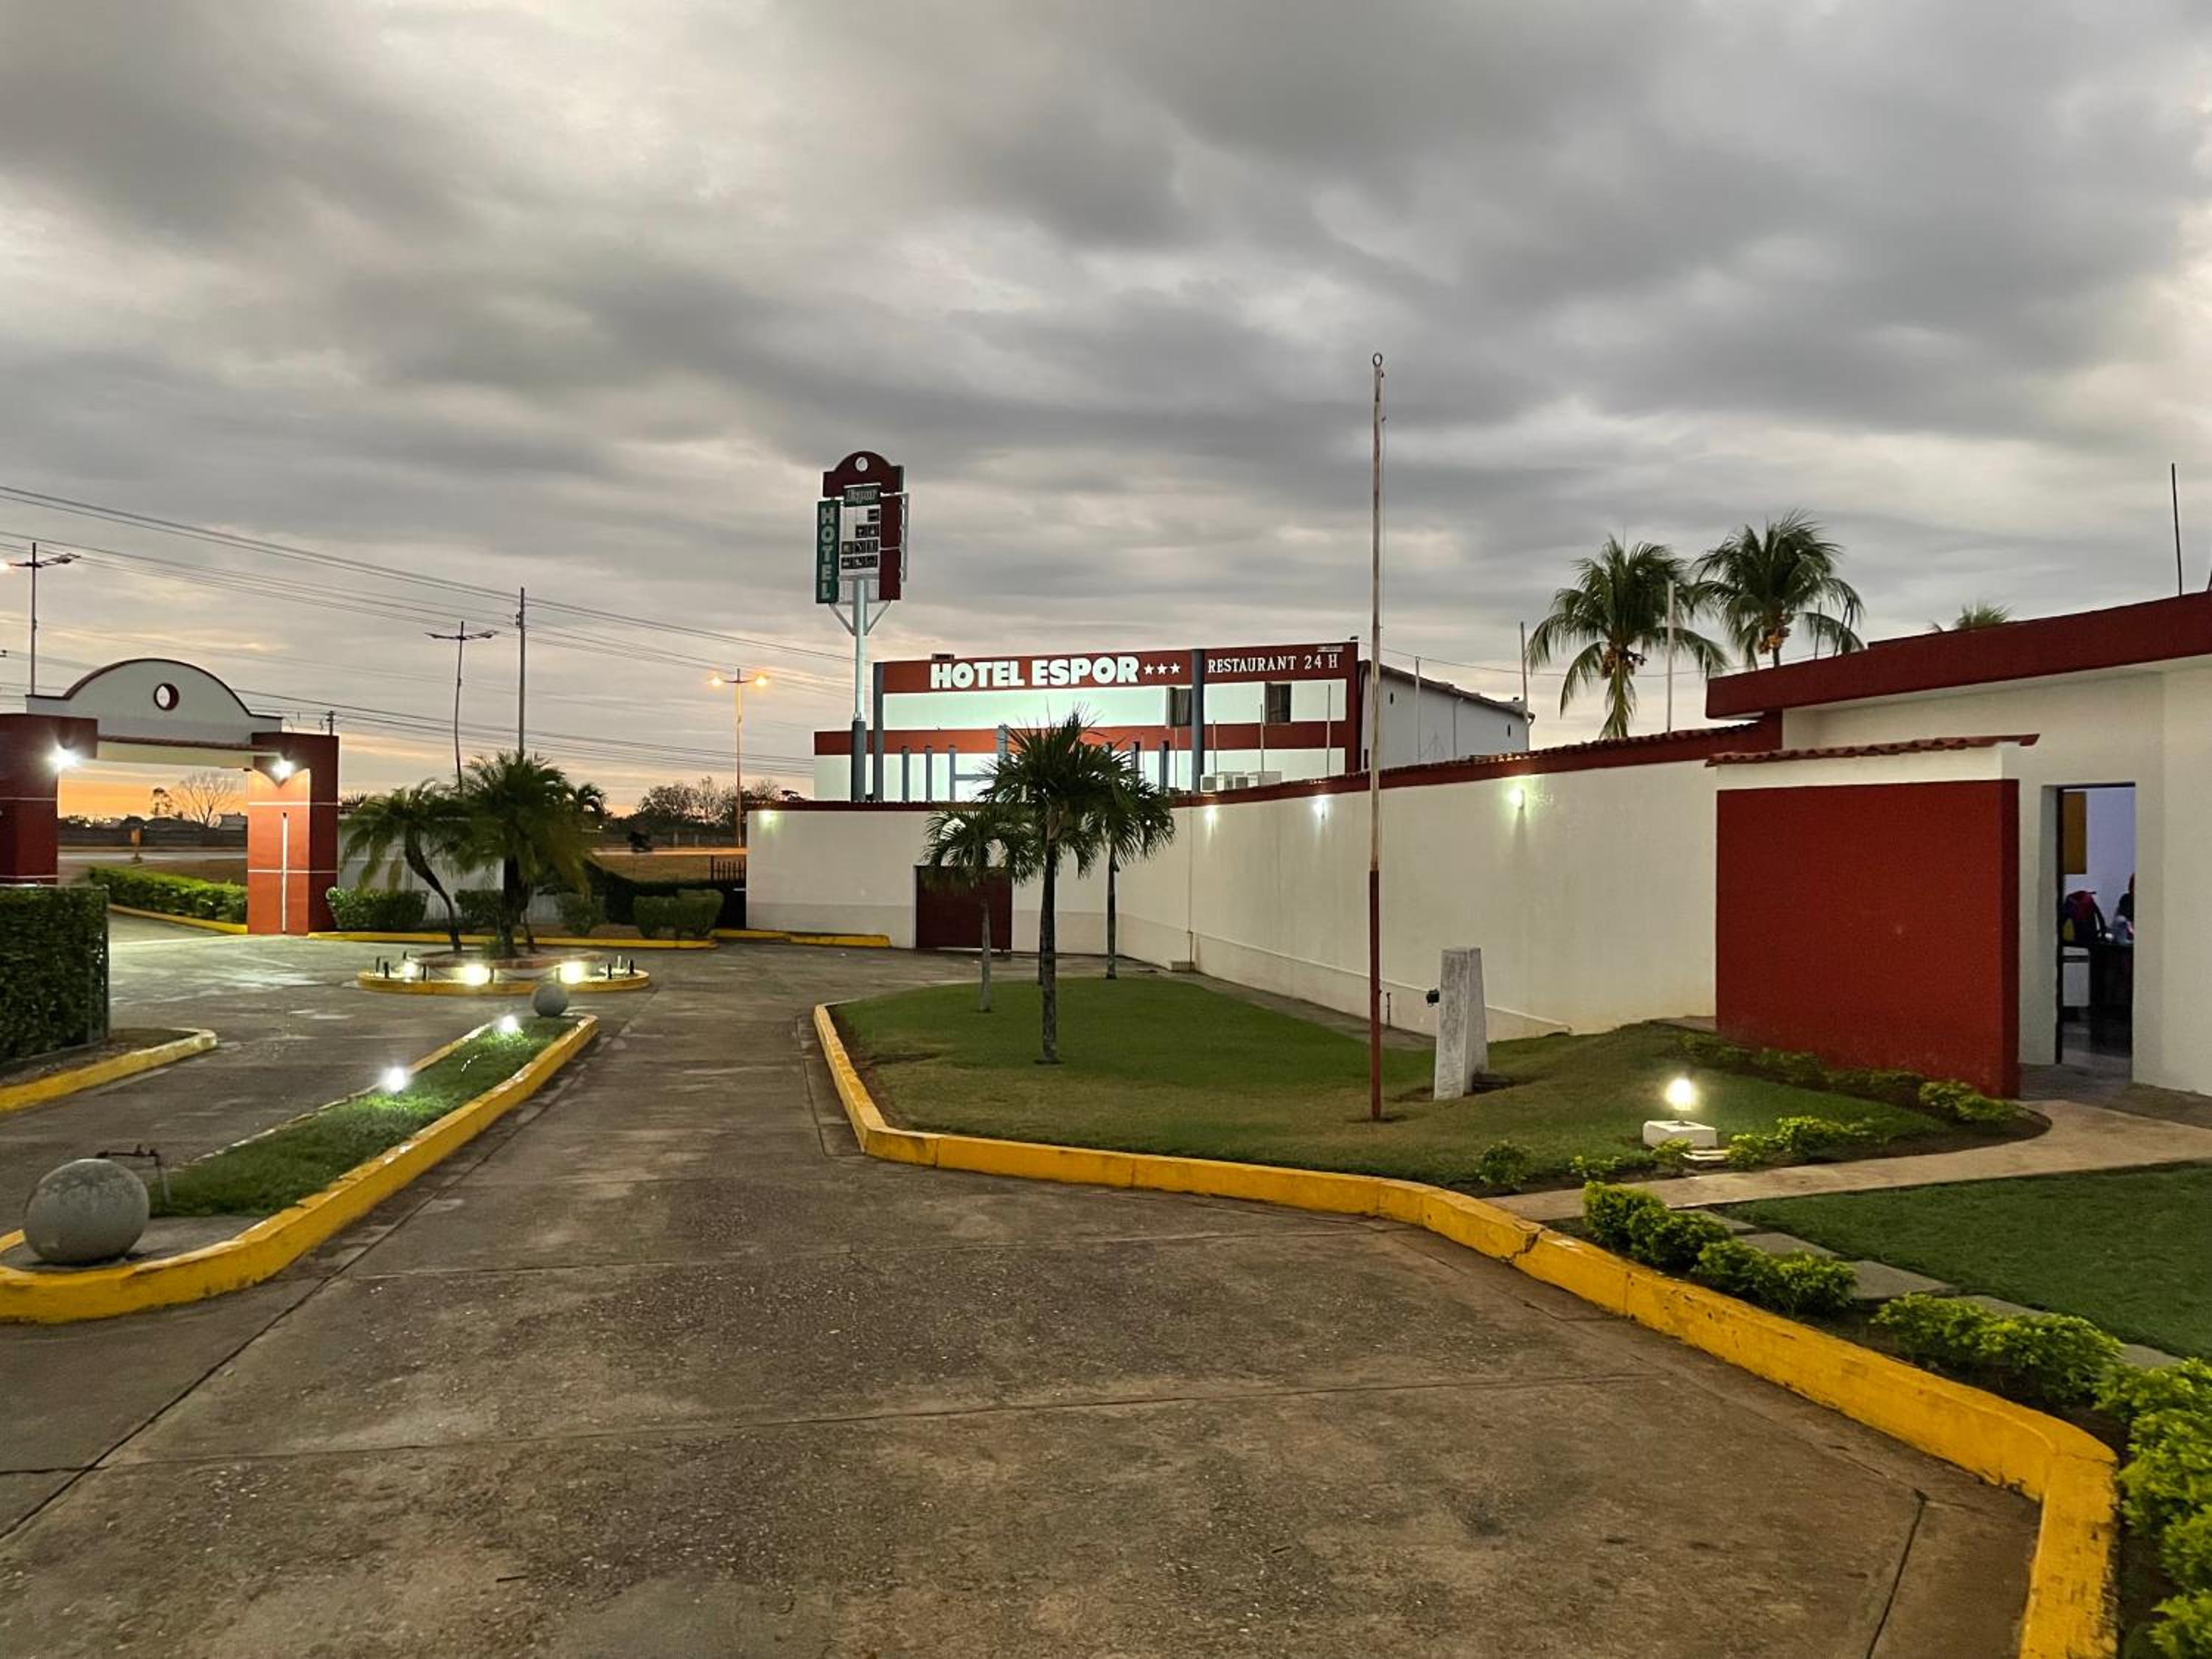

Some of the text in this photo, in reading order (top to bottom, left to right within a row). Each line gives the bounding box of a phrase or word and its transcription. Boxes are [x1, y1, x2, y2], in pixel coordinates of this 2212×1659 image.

[821, 507, 835, 599] HOTEL
[930, 655, 1140, 689] HOTEL ESPOR
[1207, 653, 1339, 673] RESTAURANT 24 H
